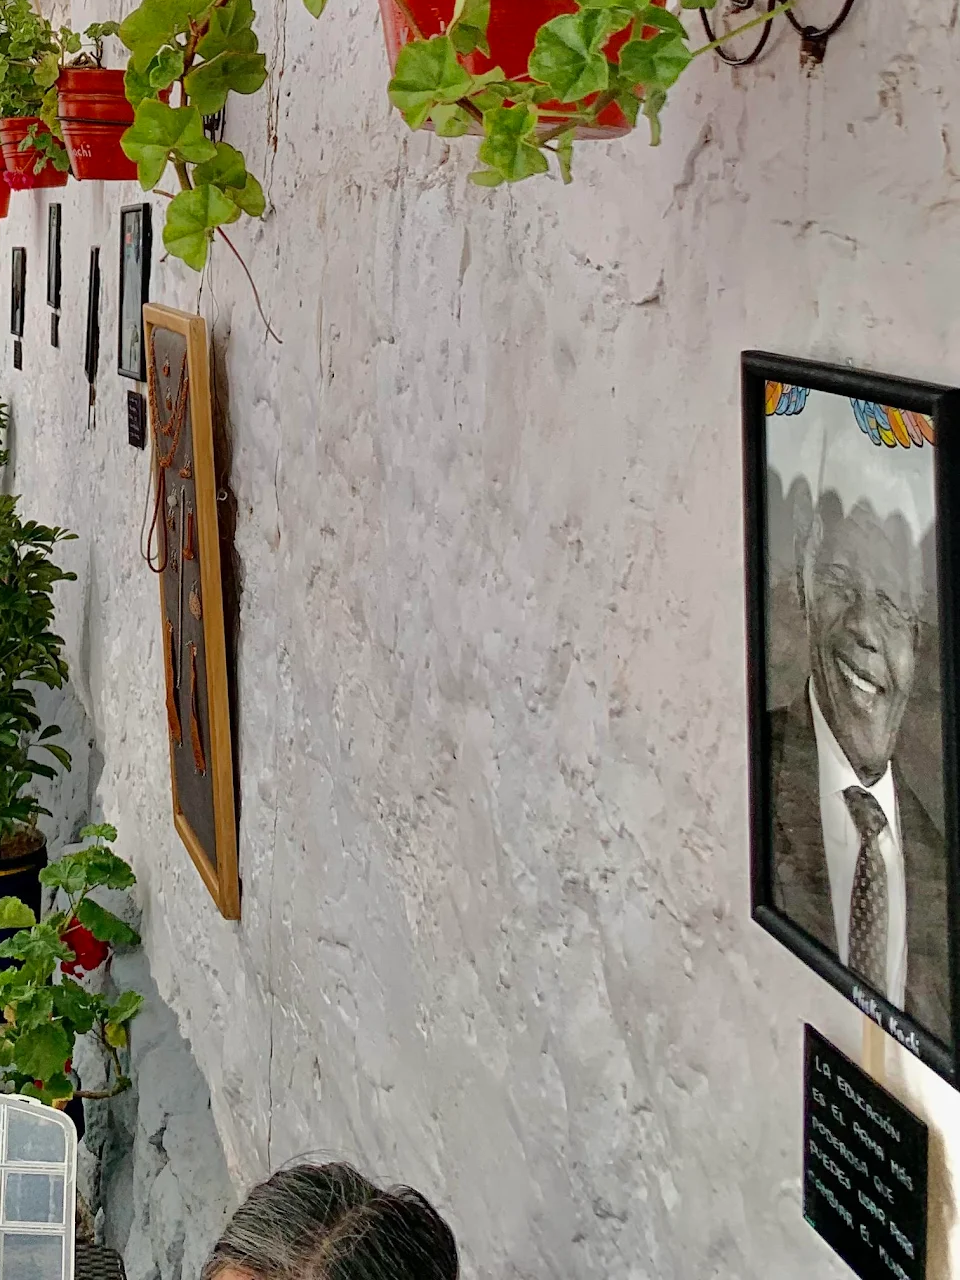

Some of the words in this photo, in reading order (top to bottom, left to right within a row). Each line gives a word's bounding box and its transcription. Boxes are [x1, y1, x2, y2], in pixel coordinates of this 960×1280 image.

[812, 1087, 826, 1106] ES
[831, 1104, 846, 1126] EL
[815, 1055, 831, 1079] LA
[836, 1075, 900, 1142] EDUCACIÓN
[873, 1175, 894, 1204] QUE
[859, 1224, 873, 1247] EL
